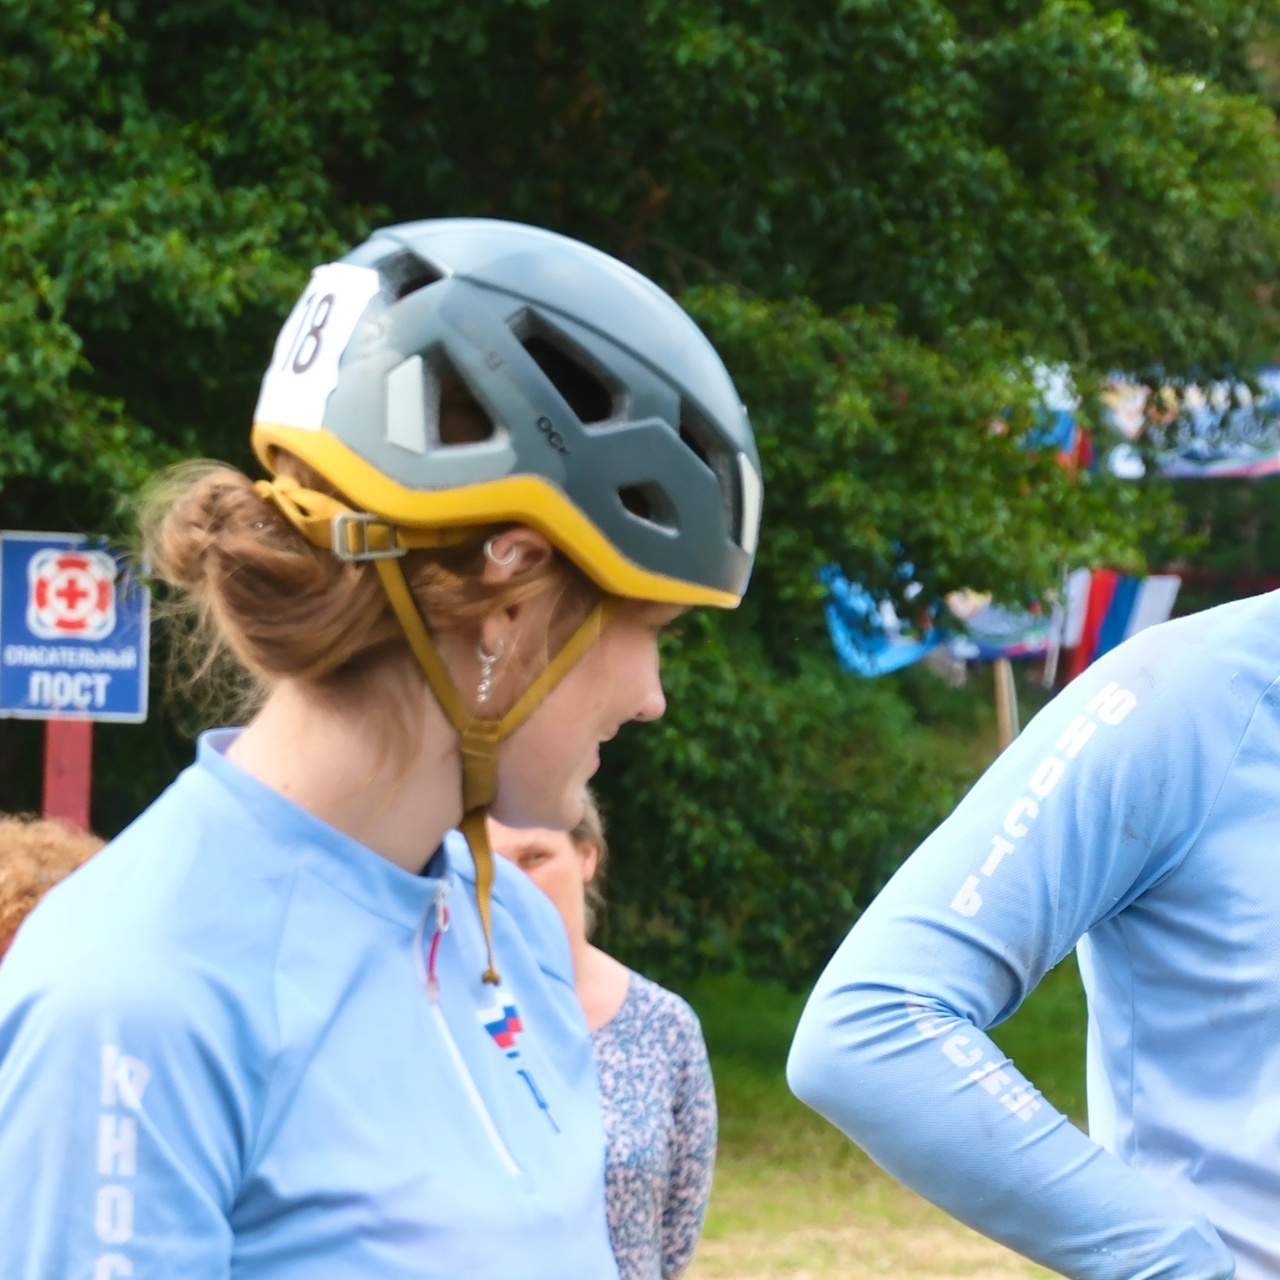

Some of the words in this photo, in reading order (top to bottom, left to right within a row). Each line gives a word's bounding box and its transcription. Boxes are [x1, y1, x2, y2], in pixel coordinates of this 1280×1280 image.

[281, 292, 336, 374] 18
[28, 670, 112, 708] ПОСТ
[949, 680, 1137, 919] ЮНОСТЬ
